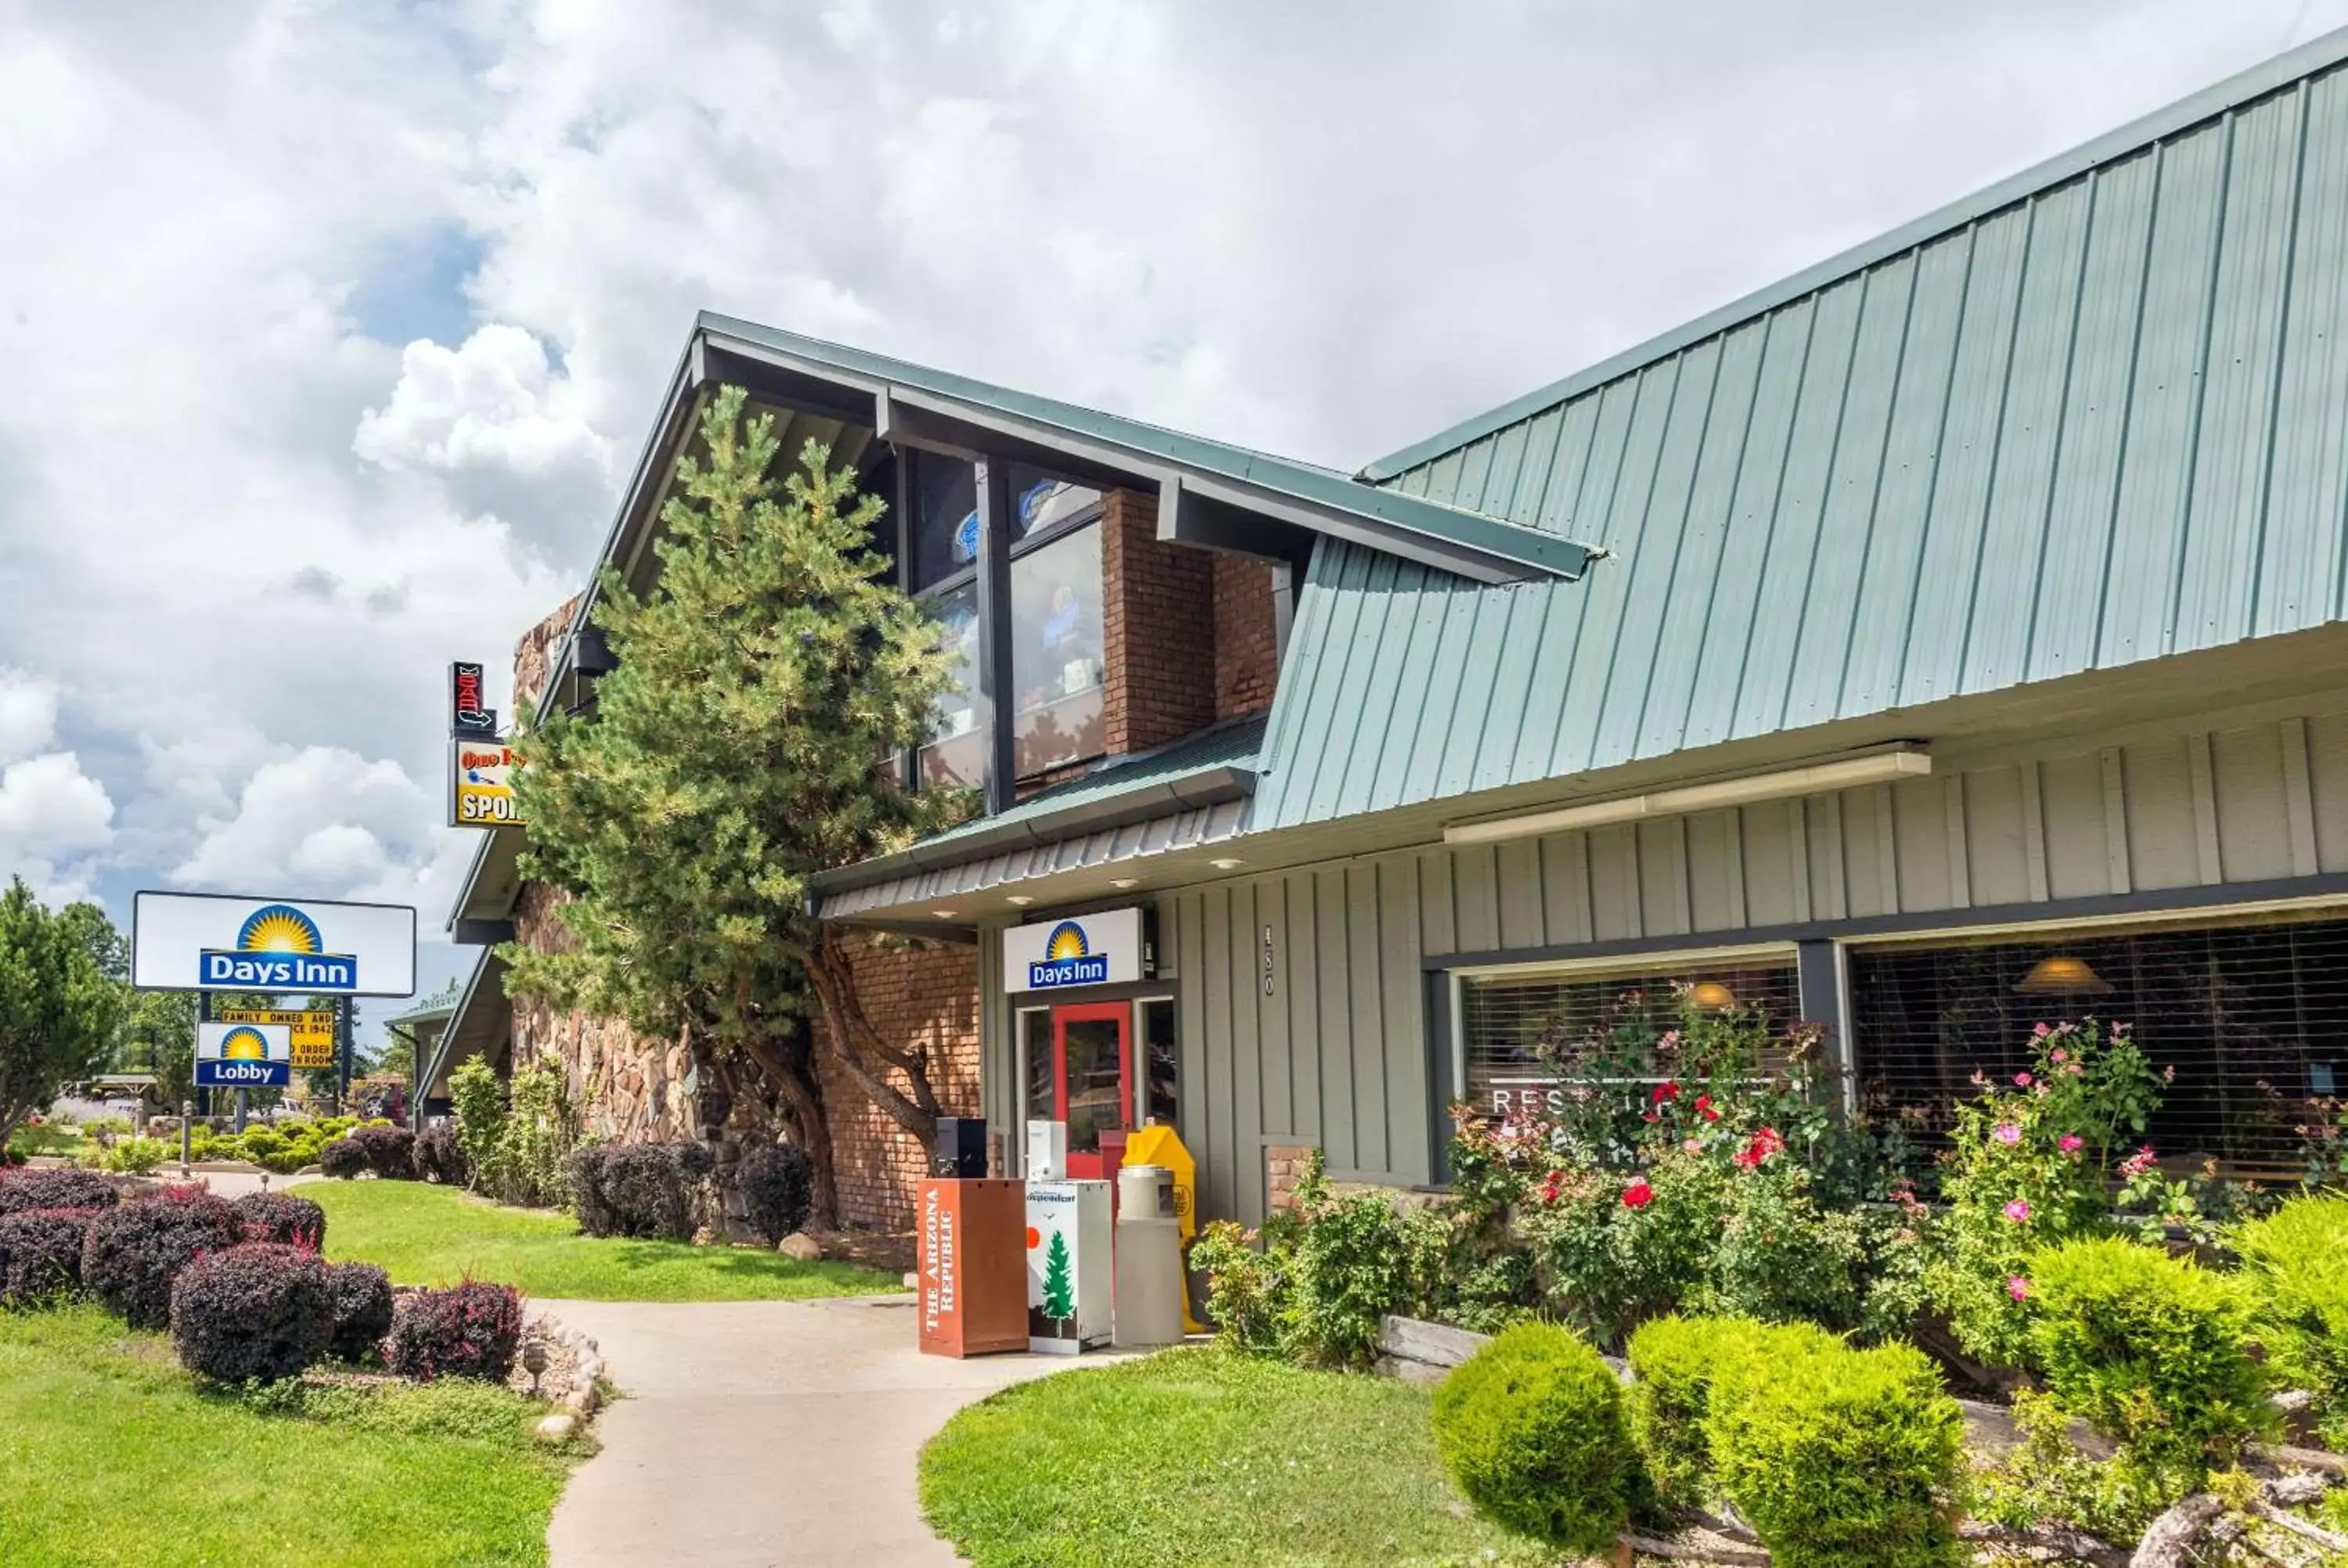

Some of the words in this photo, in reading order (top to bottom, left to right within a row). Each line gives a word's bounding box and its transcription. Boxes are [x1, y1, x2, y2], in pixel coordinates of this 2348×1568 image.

[458, 674, 478, 714] BAR
[462, 751, 500, 771] One
[210, 955, 290, 984] Days
[296, 959, 348, 983] Inn
[1034, 965, 1072, 984] Days
[1075, 962, 1103, 980] Inn
[224, 1012, 261, 1023] FAMILY
[270, 1013, 303, 1023] OWNED
[312, 1014, 331, 1023] AND
[300, 1045, 329, 1054] ORDER
[215, 1063, 273, 1084] Lobby
[1027, 1192, 1075, 1203] dependent
[926, 1189, 940, 1283] ARIZONA
[940, 1210, 953, 1312] REPUBLIC
[926, 1287, 939, 1332] THE
